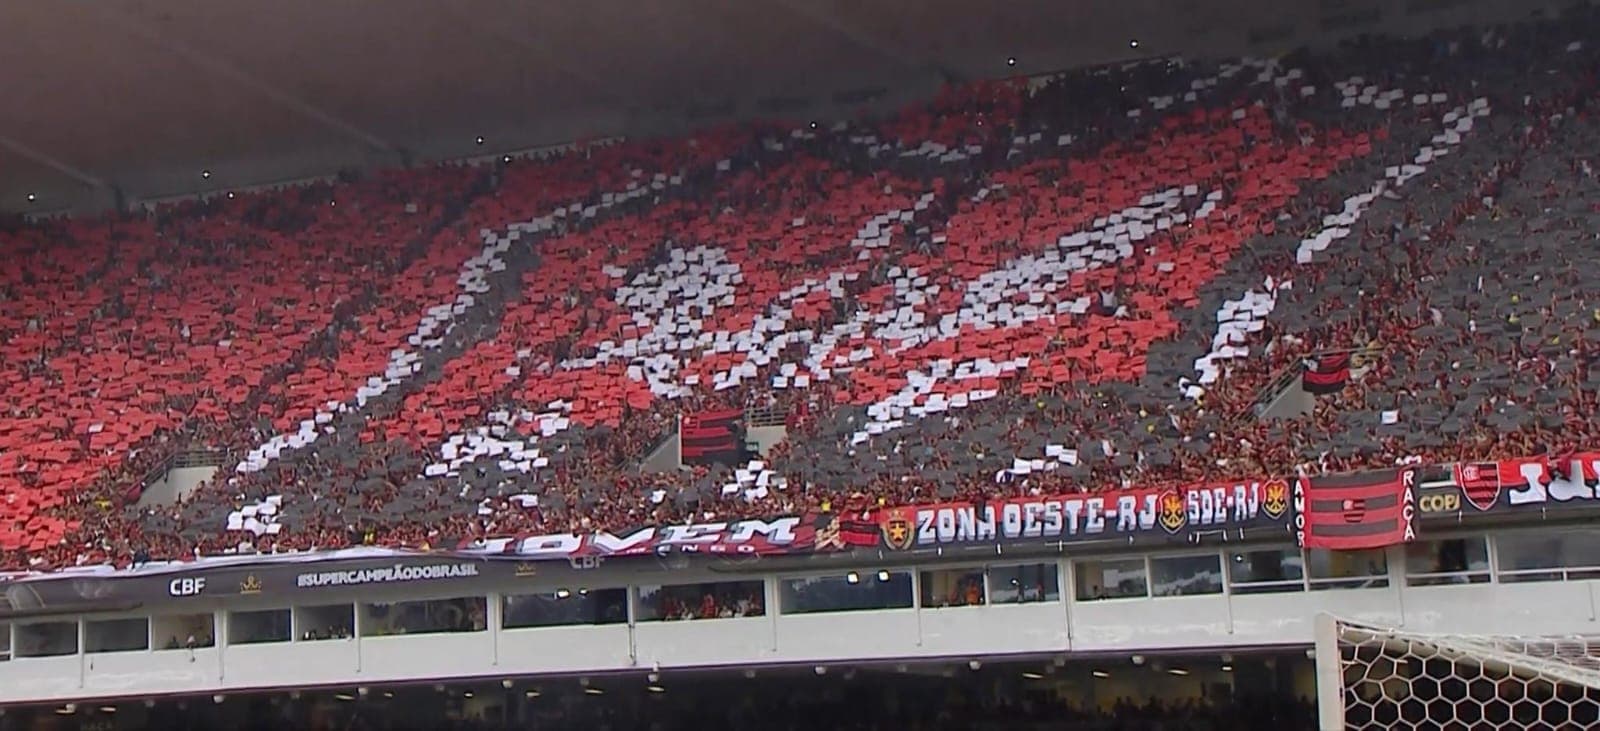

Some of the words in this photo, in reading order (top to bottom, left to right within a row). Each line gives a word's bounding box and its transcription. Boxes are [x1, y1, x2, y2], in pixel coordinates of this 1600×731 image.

[917, 505, 996, 544] ZONA
[170, 577, 207, 596] CBF
[297, 563, 479, 587] #SUPERCAMPEÃODOBRASIL
